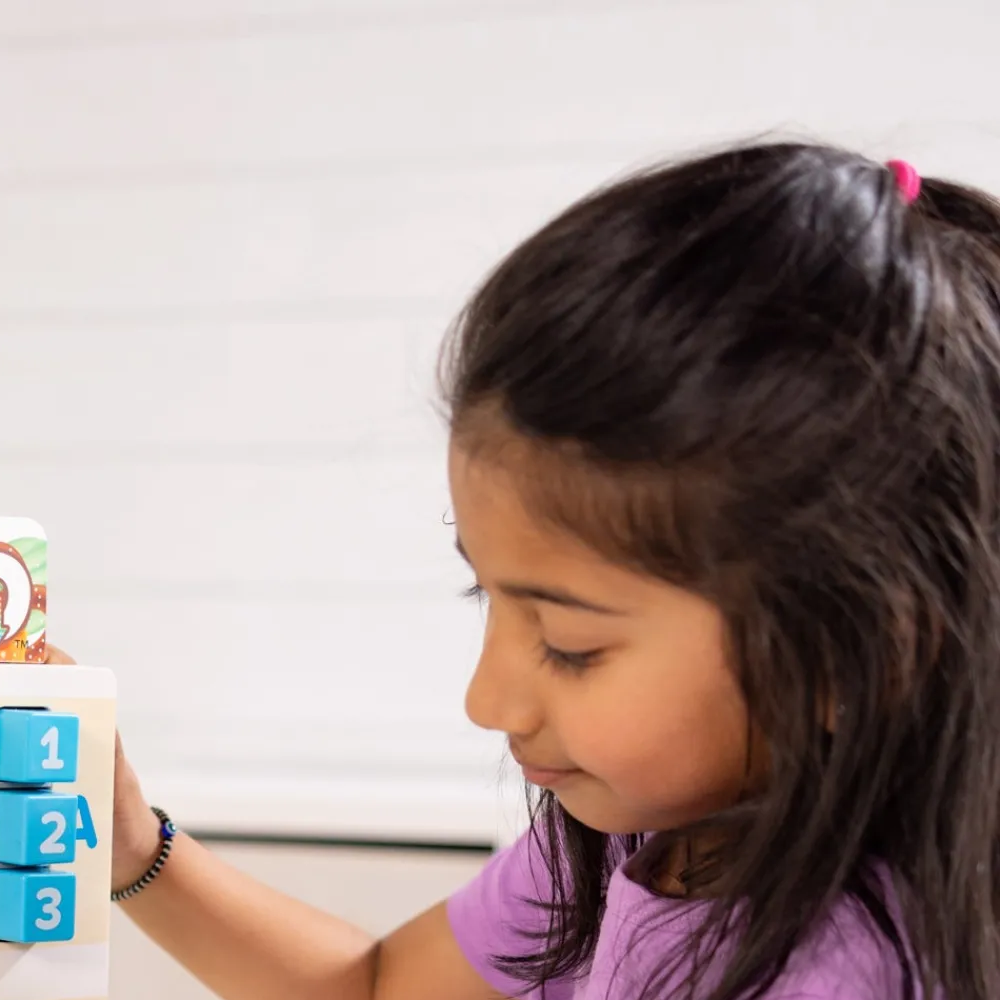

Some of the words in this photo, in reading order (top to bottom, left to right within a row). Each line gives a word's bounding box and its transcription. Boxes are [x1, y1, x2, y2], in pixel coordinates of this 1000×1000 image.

[40, 726, 65, 770] 1
[39, 811, 67, 854] 2
[35, 887, 62, 931] 3
